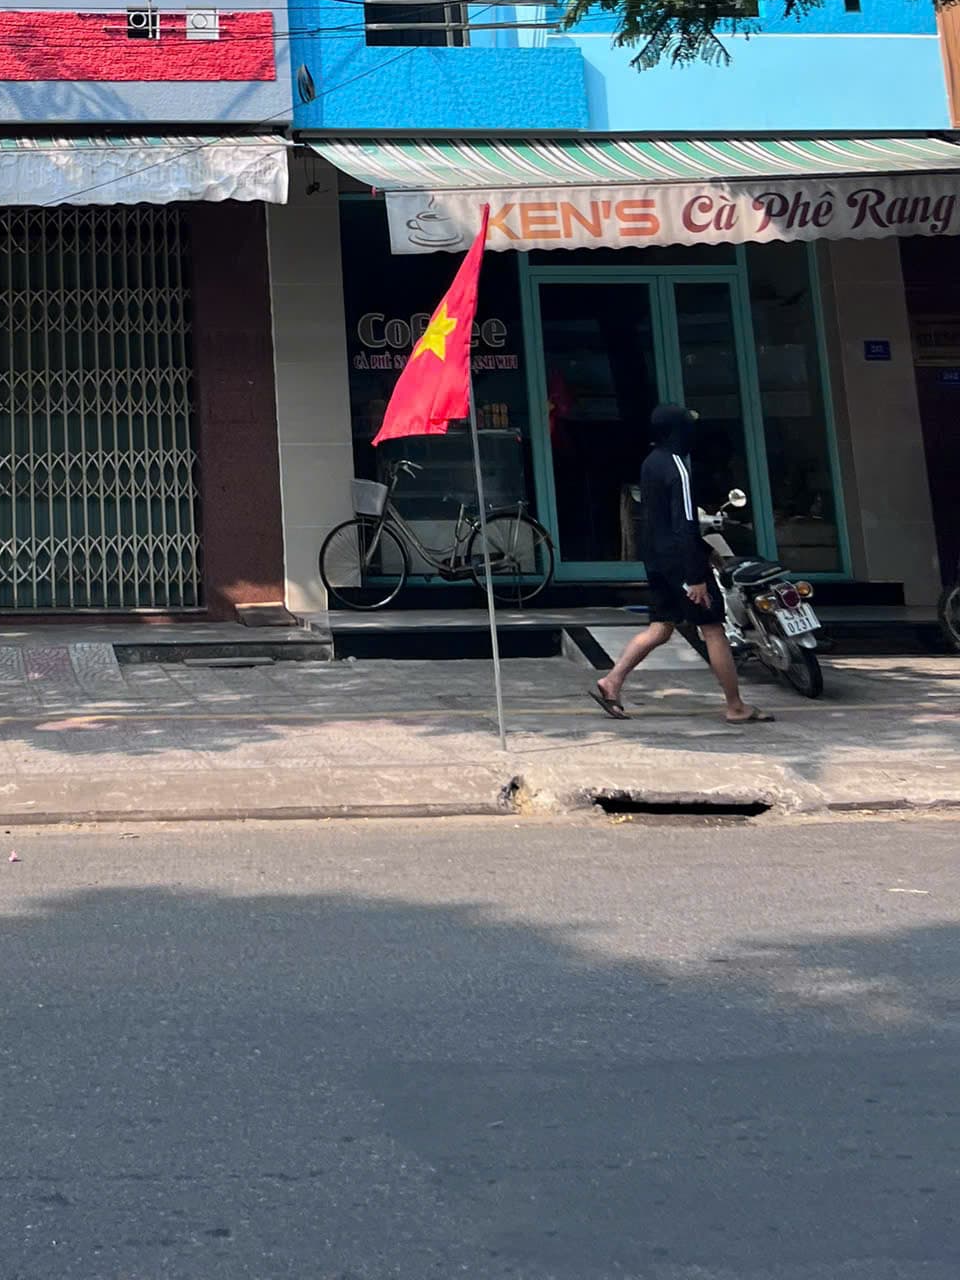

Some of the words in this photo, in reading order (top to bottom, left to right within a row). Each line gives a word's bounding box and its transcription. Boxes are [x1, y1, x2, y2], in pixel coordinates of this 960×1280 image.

[479, 199, 660, 241] KEN'S
[681, 194, 739, 233] Cà
[752, 190, 835, 233] Phê
[846, 188, 958, 234] Rang
